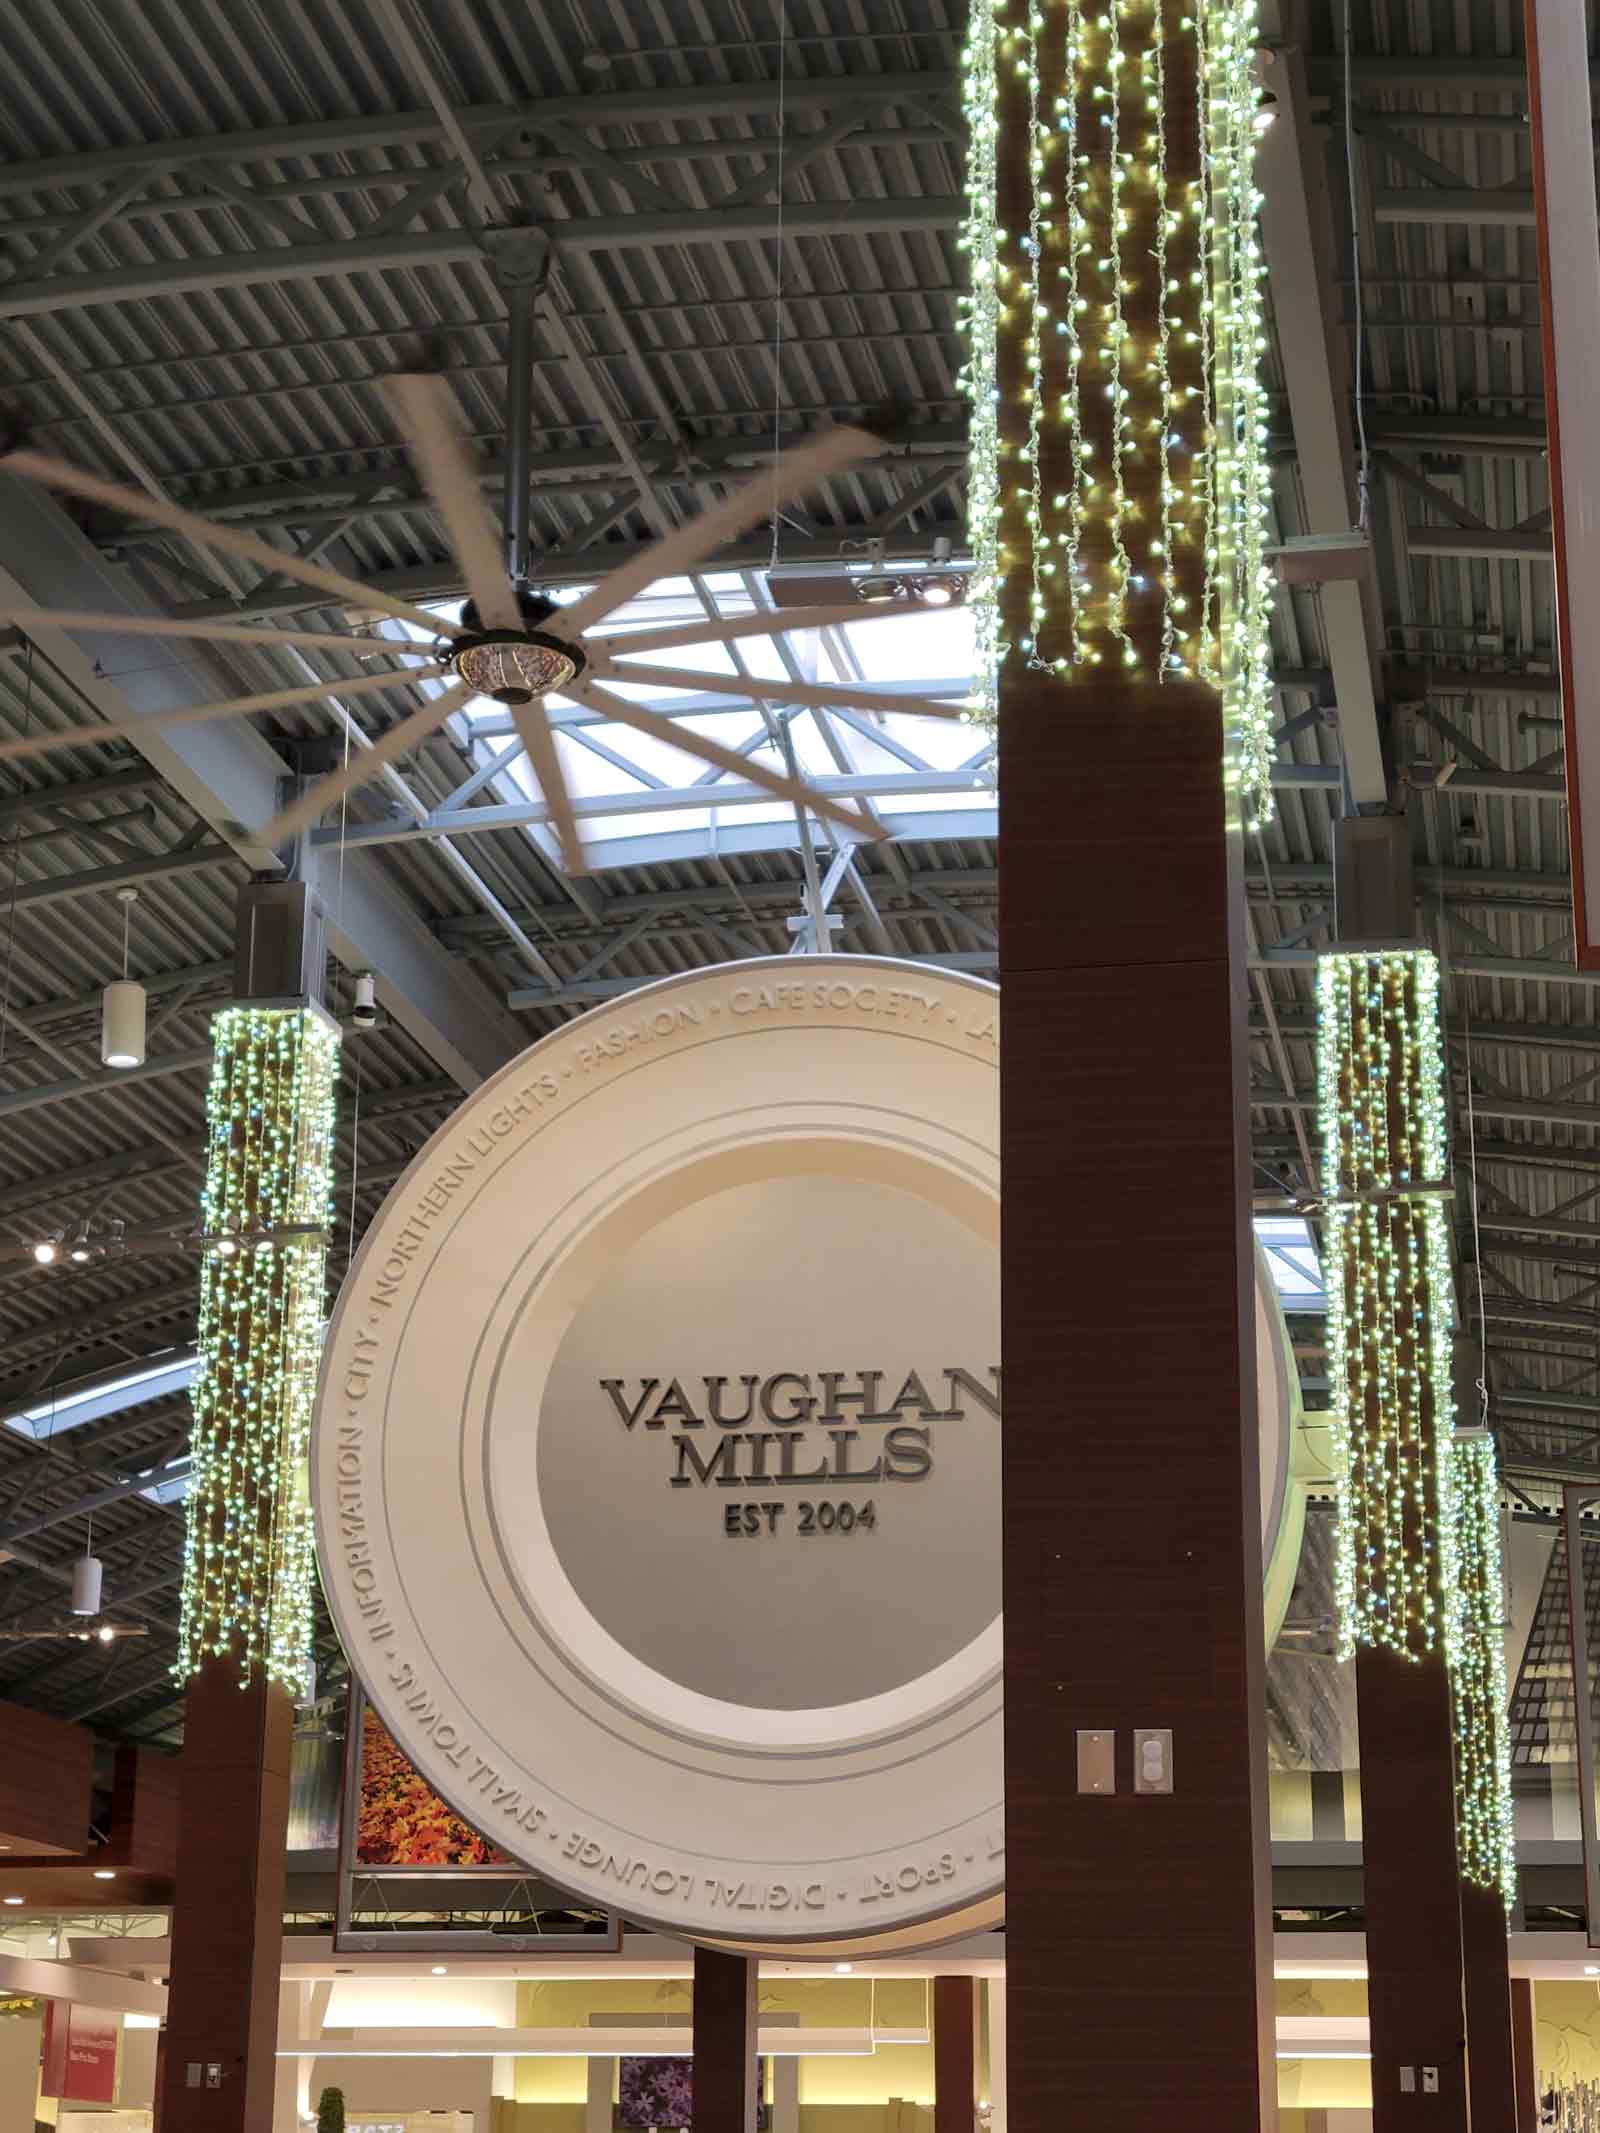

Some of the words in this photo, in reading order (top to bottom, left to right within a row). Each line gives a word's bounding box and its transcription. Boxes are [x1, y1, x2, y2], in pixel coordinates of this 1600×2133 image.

[727, 980, 809, 1015] CAFE
[811, 980, 941, 1024] SOCIETY
[577, 1002, 701, 1072] FASHION
[466, 1074, 560, 1157] LIGHTS
[369, 1152, 475, 1308] NORTHERN
[344, 1329, 380, 1400] CITY
[600, 1366, 1001, 1431] VAUGHAN
[670, 1427, 933, 1487] MILLS
[336, 1427, 395, 1643] INFORMATION
[724, 1502, 784, 1537] EST
[796, 1500, 876, 1536] 2004
[388, 1662, 471, 1768] TOWNS
[467, 1756, 547, 1833] SMALL
[562, 1832, 696, 1902] LOUNGE
[703, 1877, 826, 1911] DIGITAL
[857, 1853, 957, 1903] SPORT
